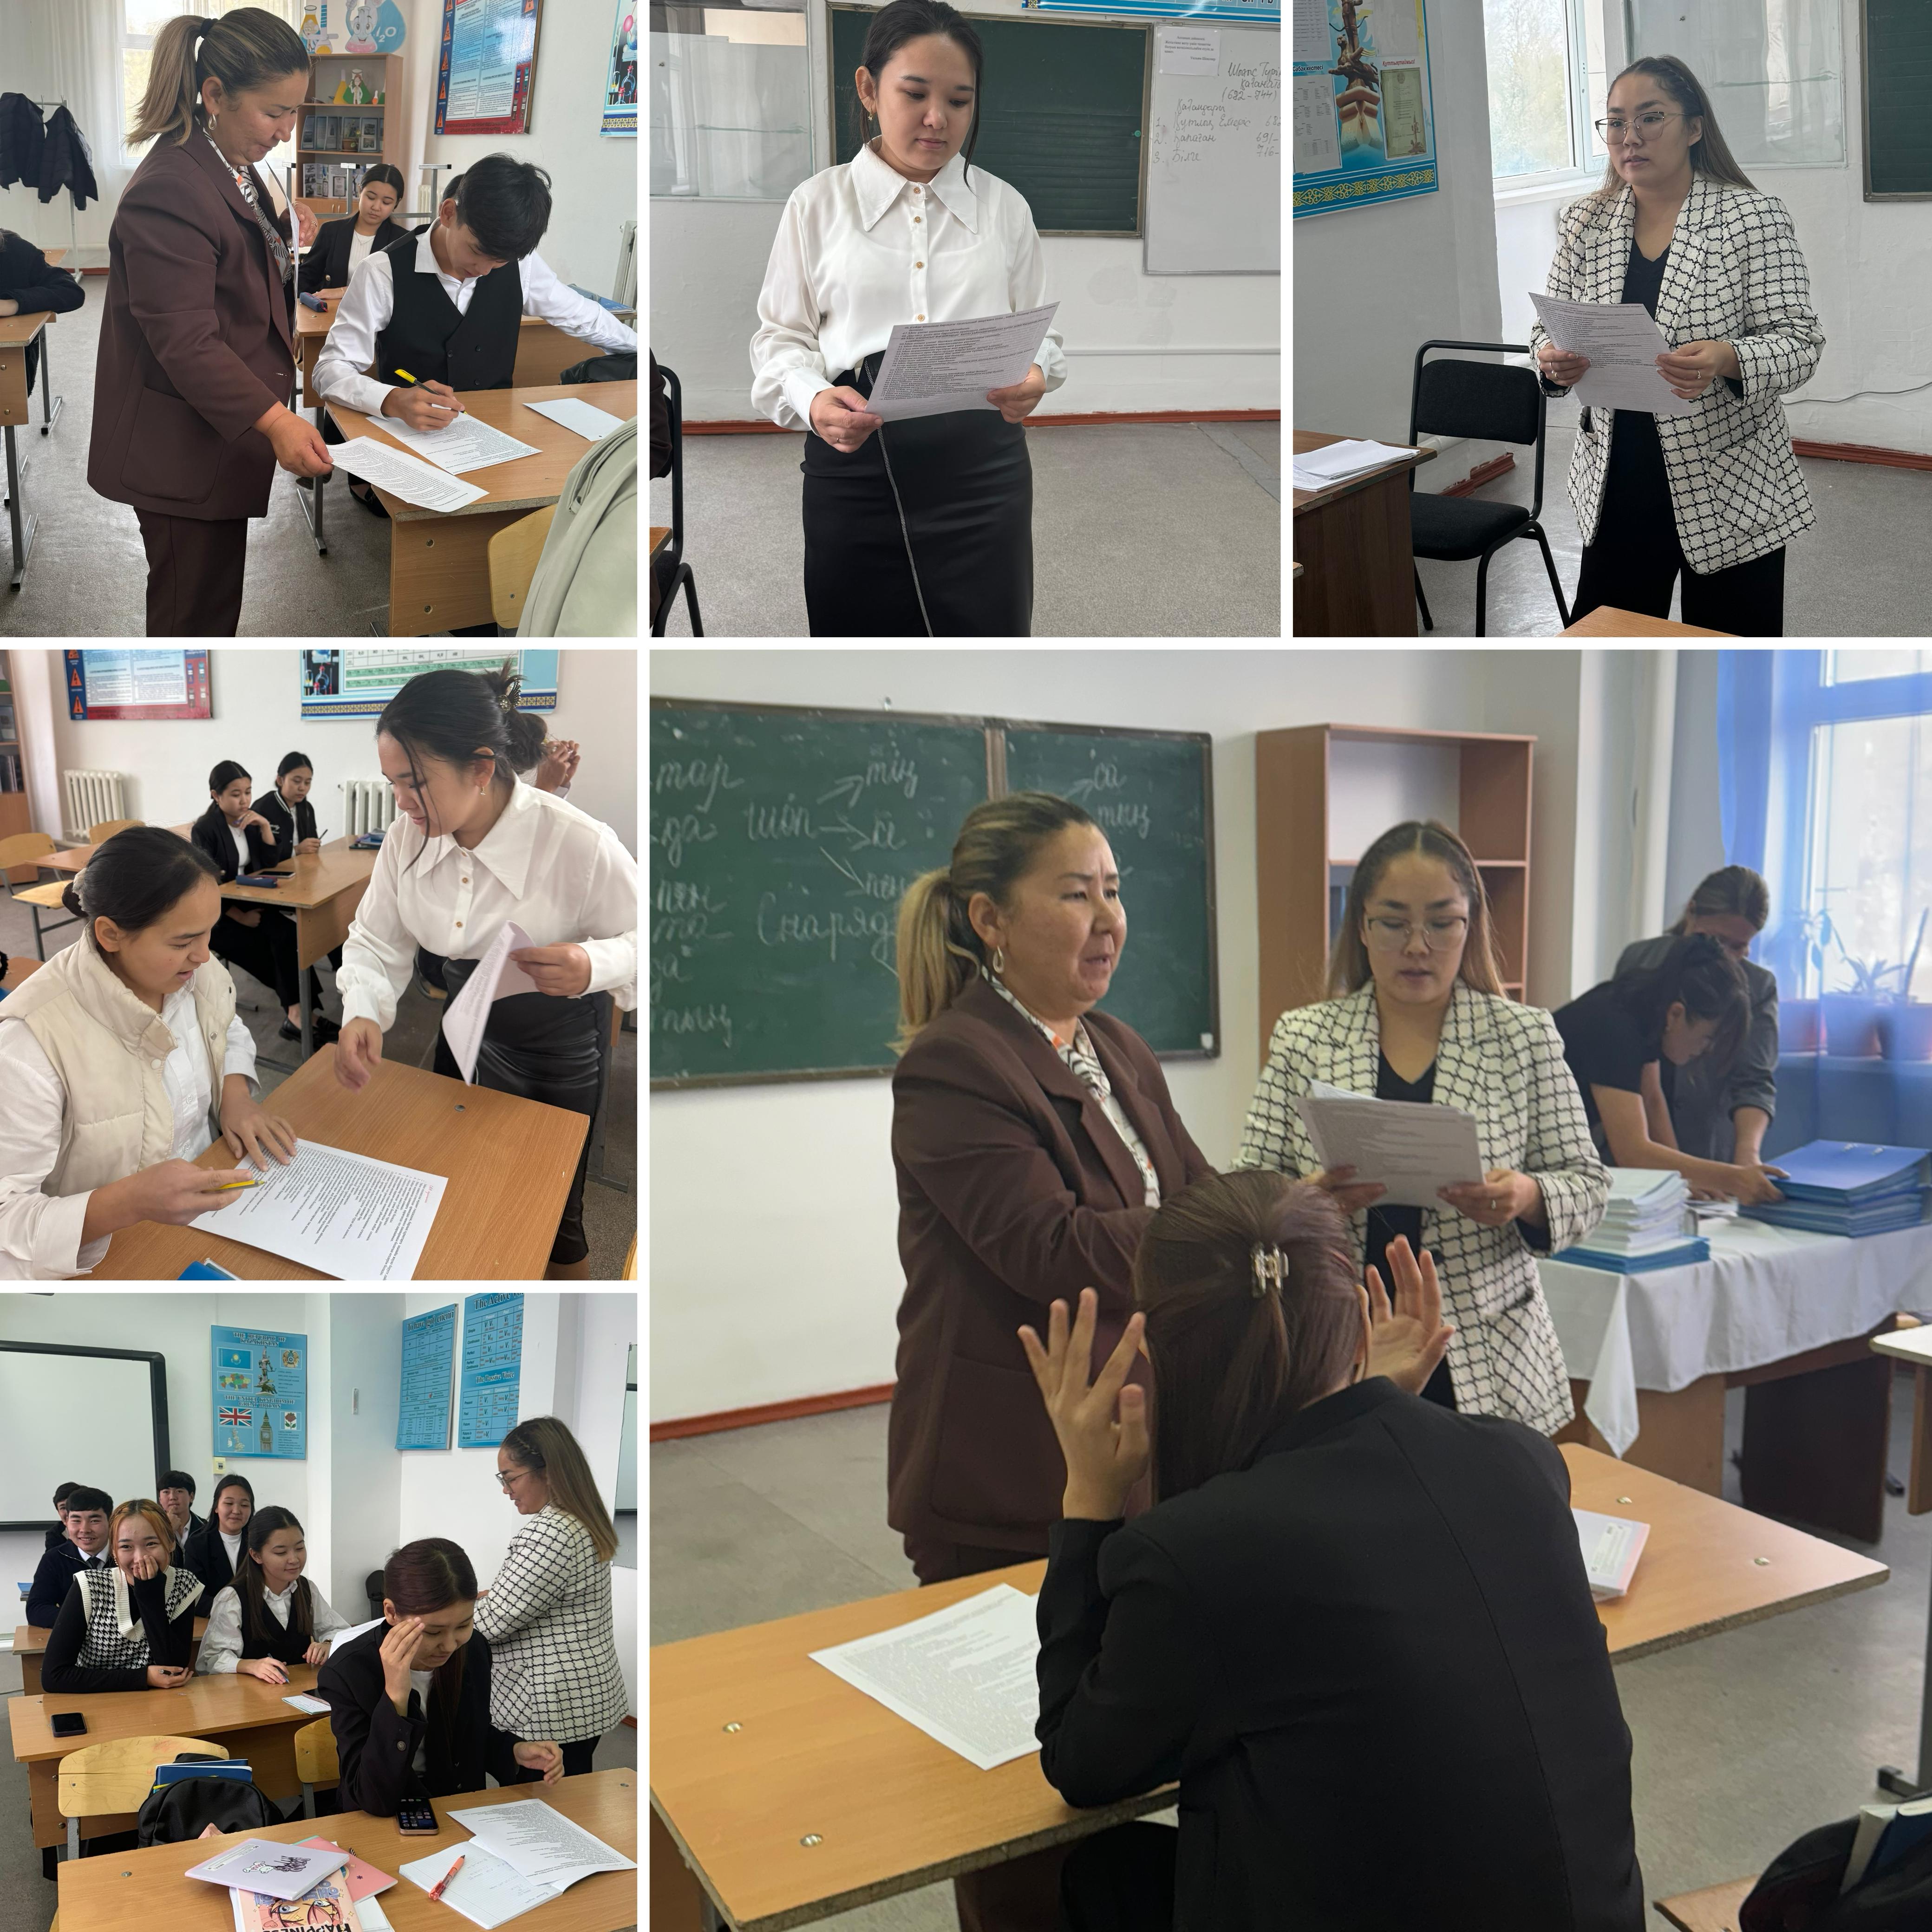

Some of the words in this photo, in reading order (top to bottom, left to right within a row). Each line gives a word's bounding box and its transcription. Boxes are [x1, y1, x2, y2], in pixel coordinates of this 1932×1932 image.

[475, 1298, 487, 1310] The
[488, 1293, 510, 1306] Active
[408, 1323, 413, 1331] To
[414, 1321, 424, 1329] have
[425, 1315, 436, 1329] (got)
[240, 1338, 279, 1347] KAZAKHSTAN
[485, 1373, 502, 1383] Passive
[502, 1371, 515, 1379] Voice
